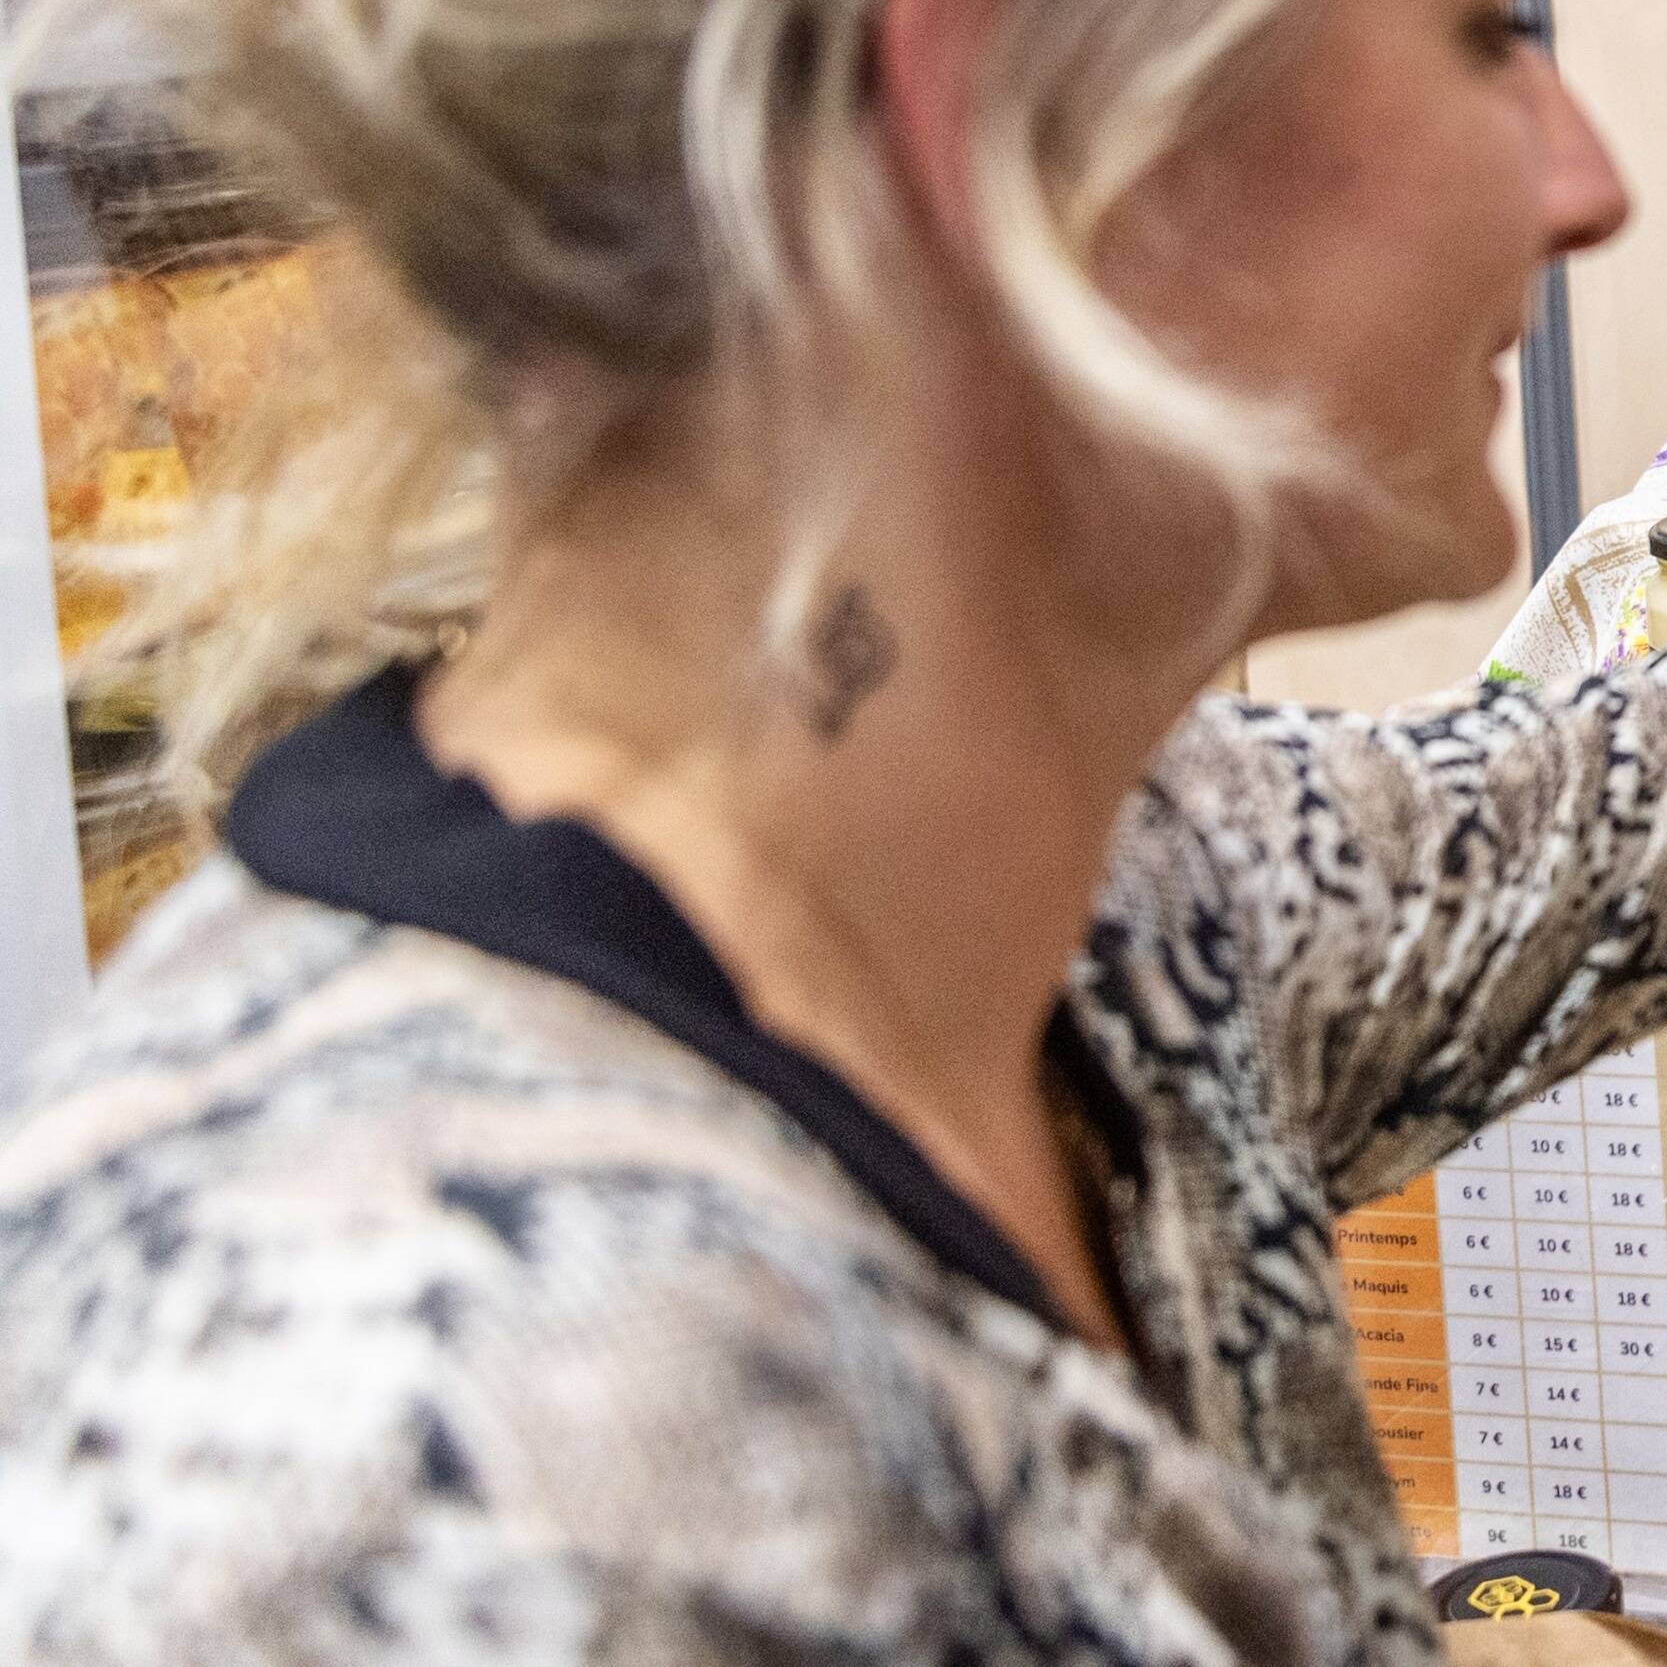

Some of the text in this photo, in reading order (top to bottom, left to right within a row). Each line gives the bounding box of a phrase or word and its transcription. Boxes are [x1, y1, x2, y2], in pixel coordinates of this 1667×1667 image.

[1338, 1230, 1418, 1248] Printemps
[1466, 1236, 1490, 1249] 6 €
[1538, 1239, 1571, 1253] 10 €
[1615, 1243, 1648, 1257] 18 €
[1353, 1278, 1408, 1296] Maquis
[1356, 1328, 1405, 1342] Acacia
[1544, 1338, 1578, 1352] 15 €
[1620, 1342, 1654, 1356] 30 €
[1551, 1437, 1583, 1451] 14 €
[1559, 1534, 1588, 1549] 18€
